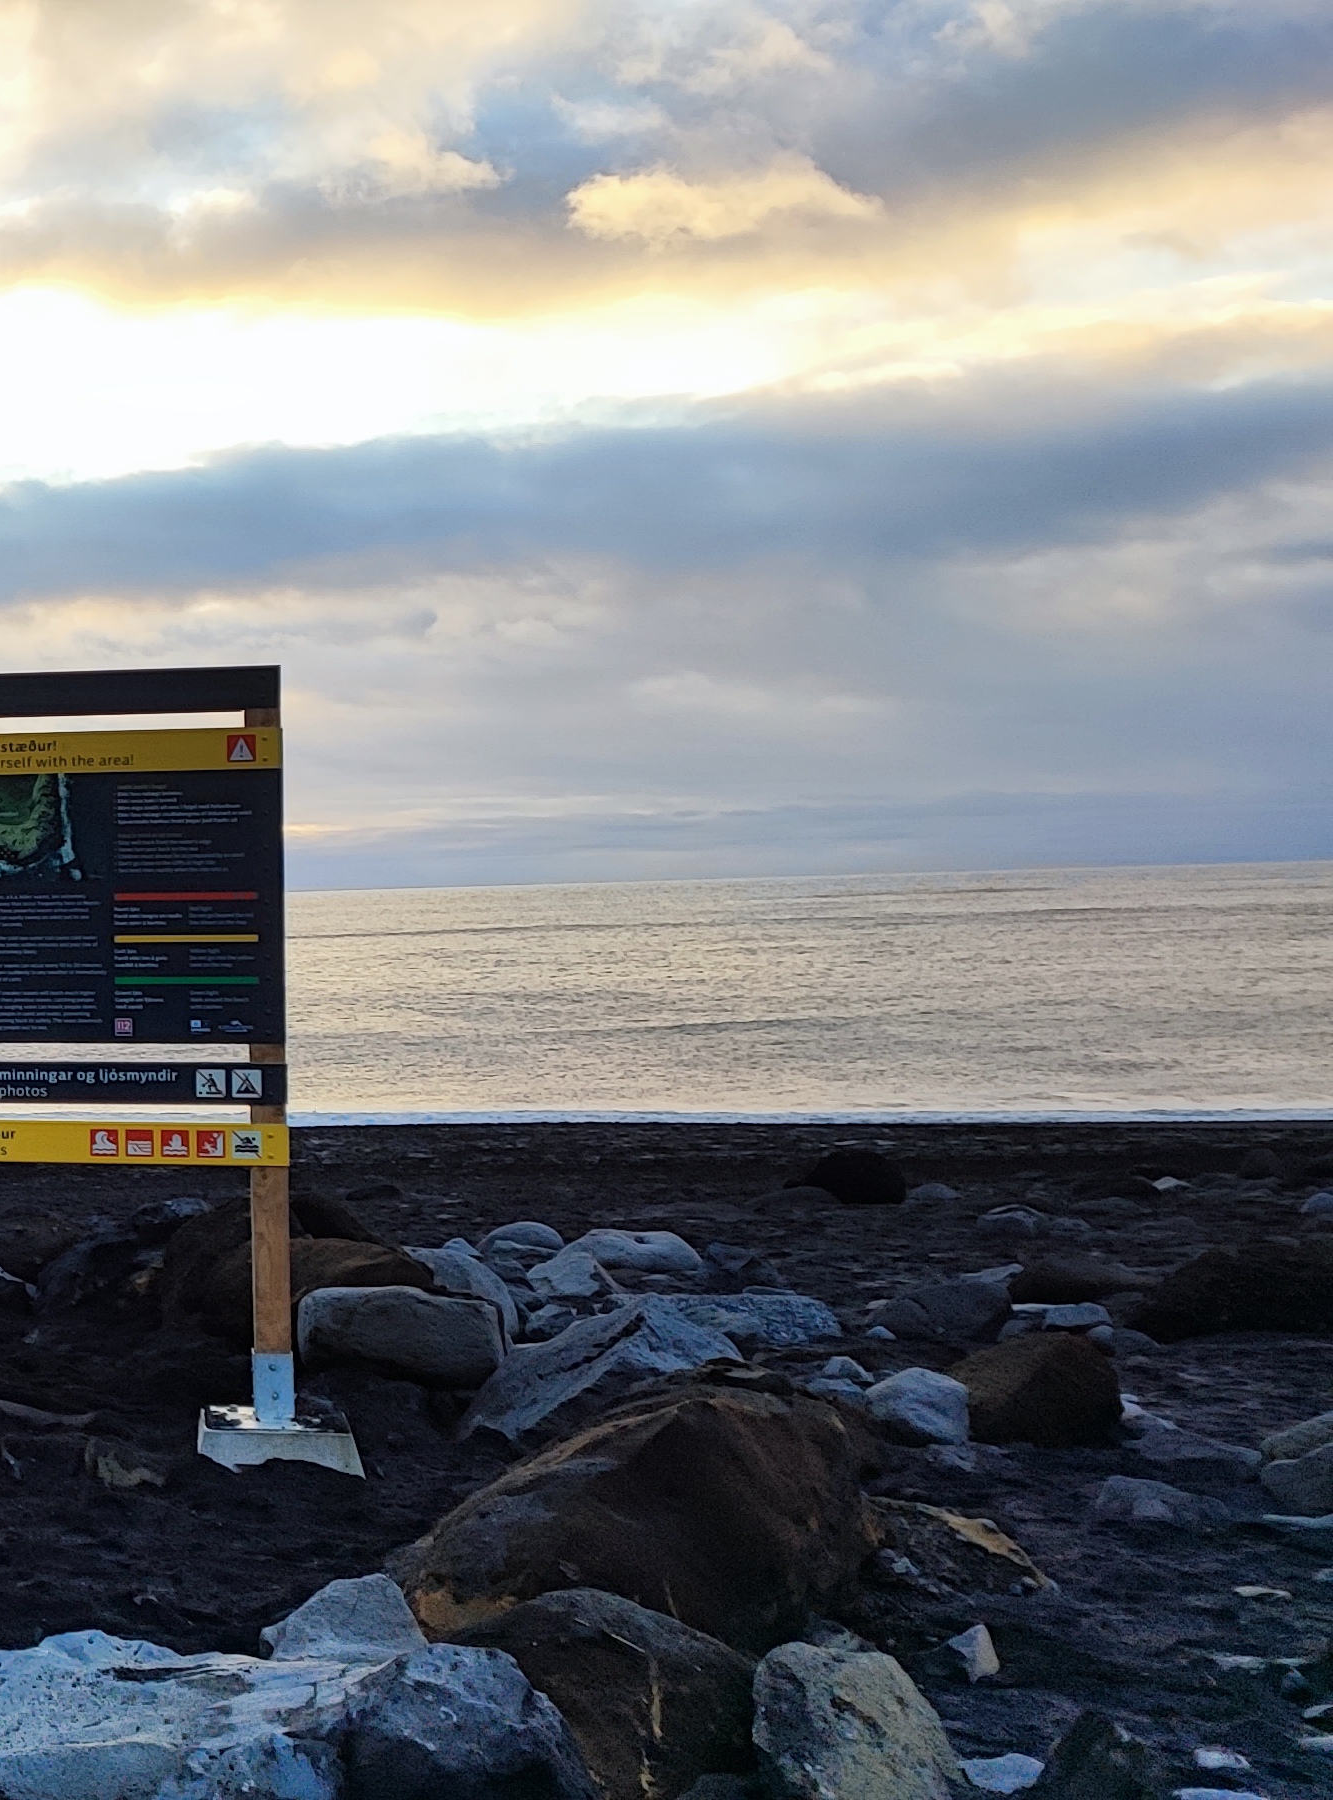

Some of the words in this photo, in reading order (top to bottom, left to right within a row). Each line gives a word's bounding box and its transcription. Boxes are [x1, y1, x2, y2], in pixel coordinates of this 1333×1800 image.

[36, 755, 67, 767] with
[72, 755, 94, 766] the
[99, 754, 134, 766] area!
[117, 1021, 130, 1030] 112
[0, 1069, 73, 1083] minningar
[77, 1072, 95, 1083] og
[99, 1068, 178, 1084] ljósmyndir
[0, 1085, 48, 1099] photos
